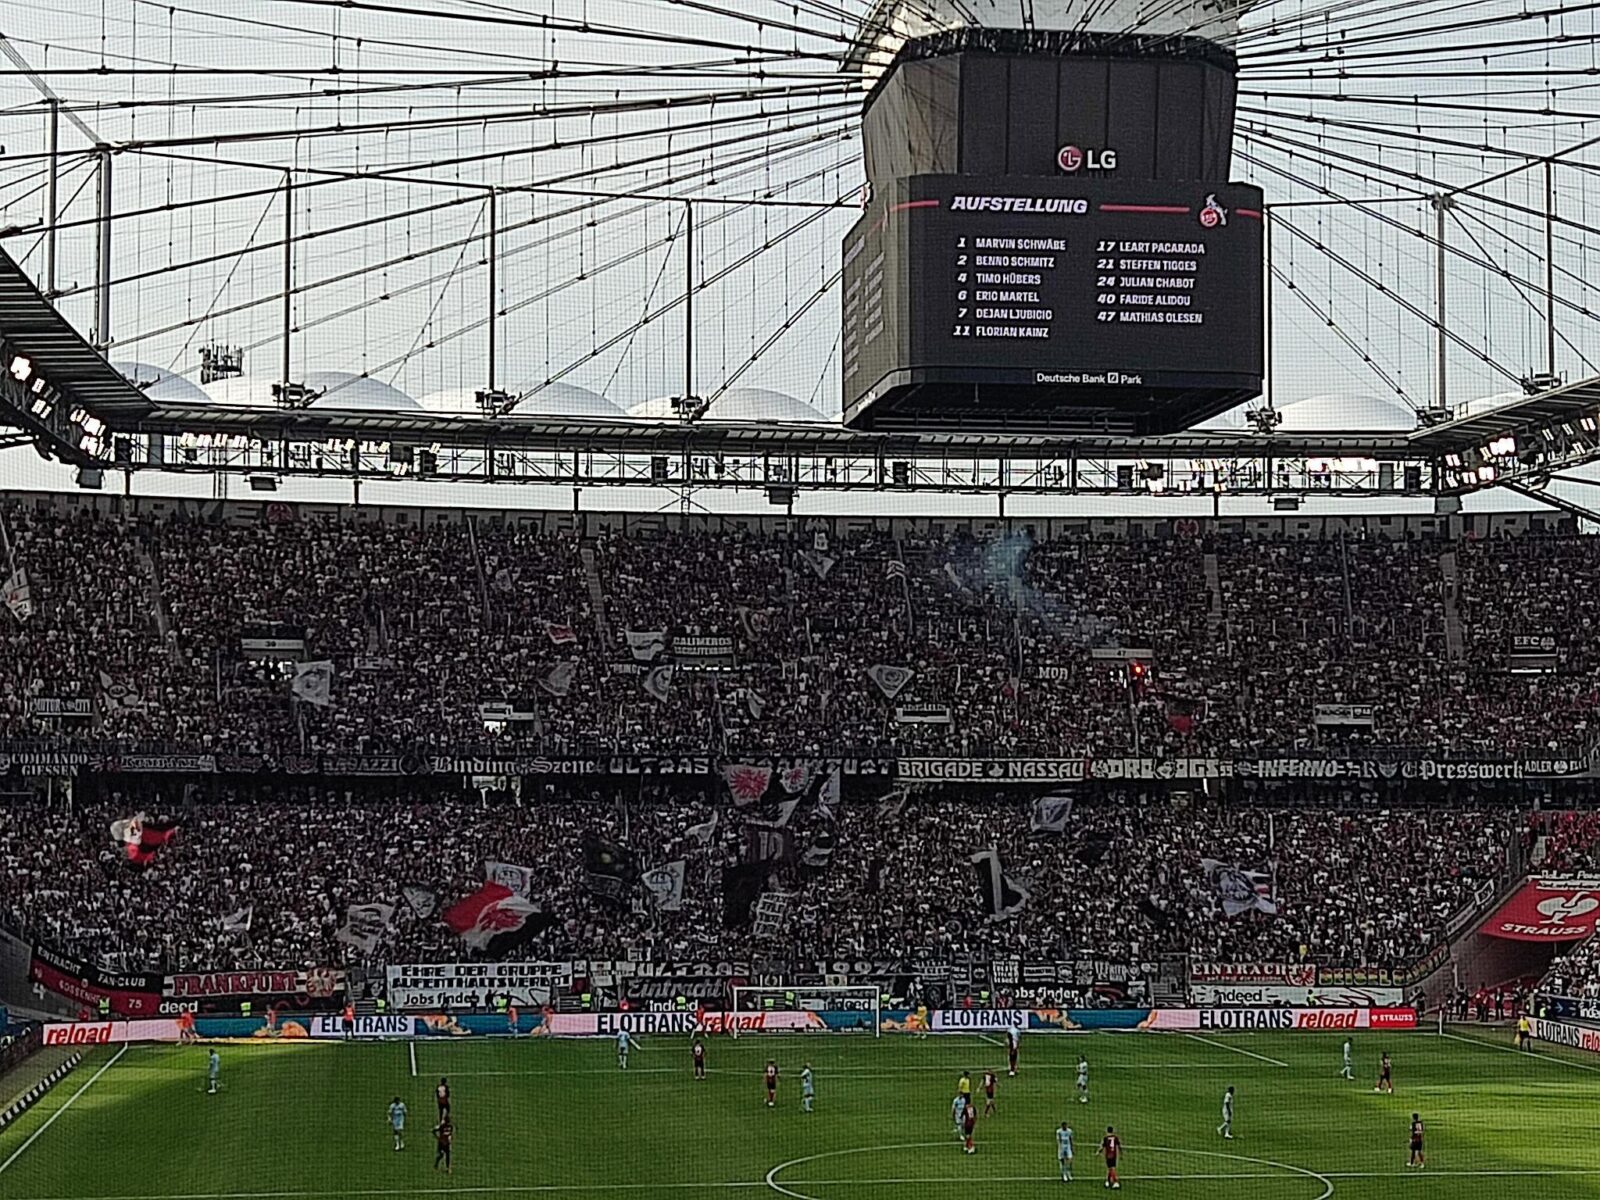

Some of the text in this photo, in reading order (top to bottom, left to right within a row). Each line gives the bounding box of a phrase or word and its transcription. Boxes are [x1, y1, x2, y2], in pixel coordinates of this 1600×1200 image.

[1087, 150, 1116, 169] LG
[950, 196, 1088, 214] AUFSTELLUNG
[957, 237, 1066, 251] 1 MARVIN SCHWÄBE
[1096, 241, 1206, 254] 17 LEART PACARADA
[957, 255, 1055, 268] 2 BENNO SCHMITZ
[1096, 259, 1115, 269] 21
[1119, 259, 1161, 270] STEFFEN
[957, 272, 1041, 284] 4 TIMO HÜBERS
[1096, 276, 1196, 289] 24 JULIAN CHABOT
[957, 290, 1040, 302] 6 ERIC MARTEL
[1096, 294, 1191, 306] 40 FARIDE ALIDOU
[958, 308, 968, 318] 7
[976, 308, 1008, 319] DEJAN
[1096, 312, 1203, 324] 47 MATHIAS OLESEN
[953, 326, 1049, 338] 11 FLORIAN KAINZ
[1036, 373, 1142, 385] Deutsche Bank Park
[21, 764, 80, 776] GIESSEN
[430, 756, 518, 775] Binding
[898, 761, 1085, 778] BRIGADE NASSAU
[1420, 760, 1525, 781] Presswerk
[1524, 760, 1553, 773] ADLER
[1500, 923, 1588, 935] STRAUSS
[37, 945, 83, 976] EINTRACHT
[401, 964, 562, 977] EHRE DER GRUPPE
[174, 970, 299, 996] FRANKFURT
[403, 993, 435, 1005] Jobs
[1217, 989, 1264, 1003] ndeed
[127, 998, 143, 1009] 75
[649, 1000, 699, 1013] indd
[598, 1013, 698, 1033] ELOTRANS
[941, 1010, 1024, 1027] ELOTRANS
[1199, 1009, 1359, 1029] ELOTRANS reload
[1379, 1013, 1414, 1022] STRAUSS
[321, 1016, 408, 1033] ELTRANS
[47, 1023, 113, 1044] reload
[1536, 1019, 1581, 1048] ELOTRANS
